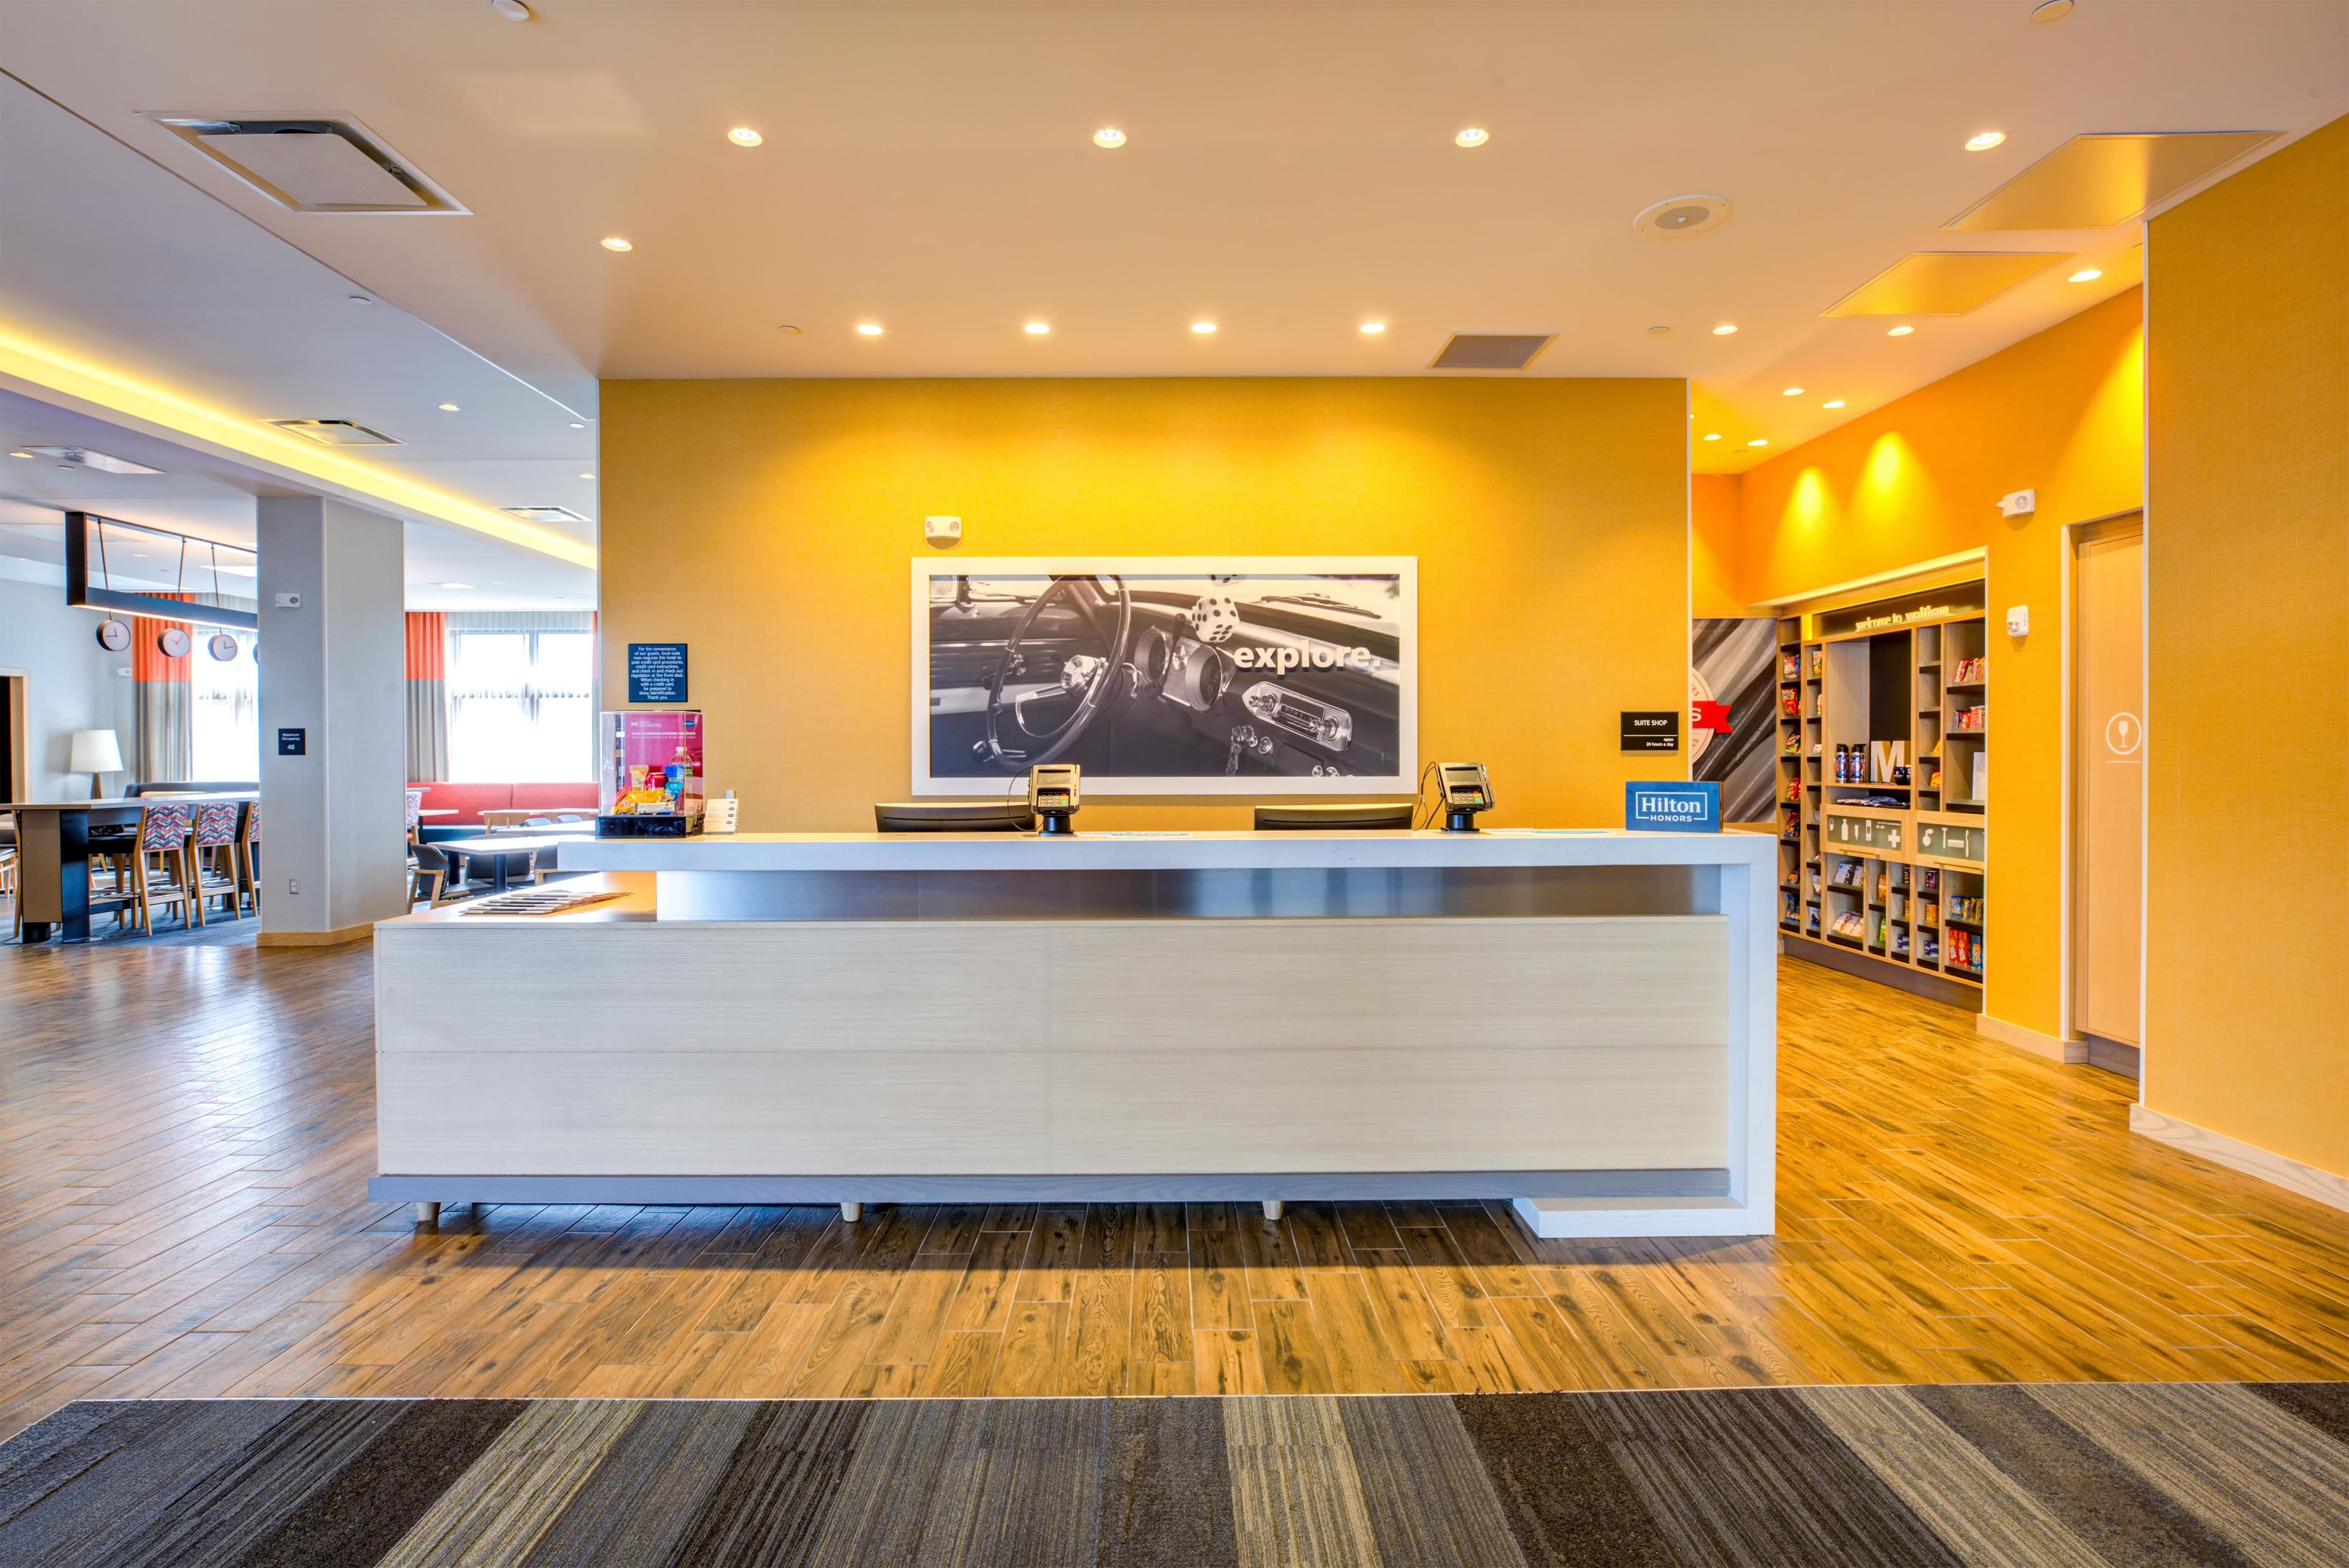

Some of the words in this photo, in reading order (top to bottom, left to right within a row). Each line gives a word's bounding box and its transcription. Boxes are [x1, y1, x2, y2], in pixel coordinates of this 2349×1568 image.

[1855, 617, 1891, 630] welcome
[1893, 613, 1902, 623] to
[1233, 640, 1380, 675] explore.
[1641, 797, 1701, 813] Hilton
